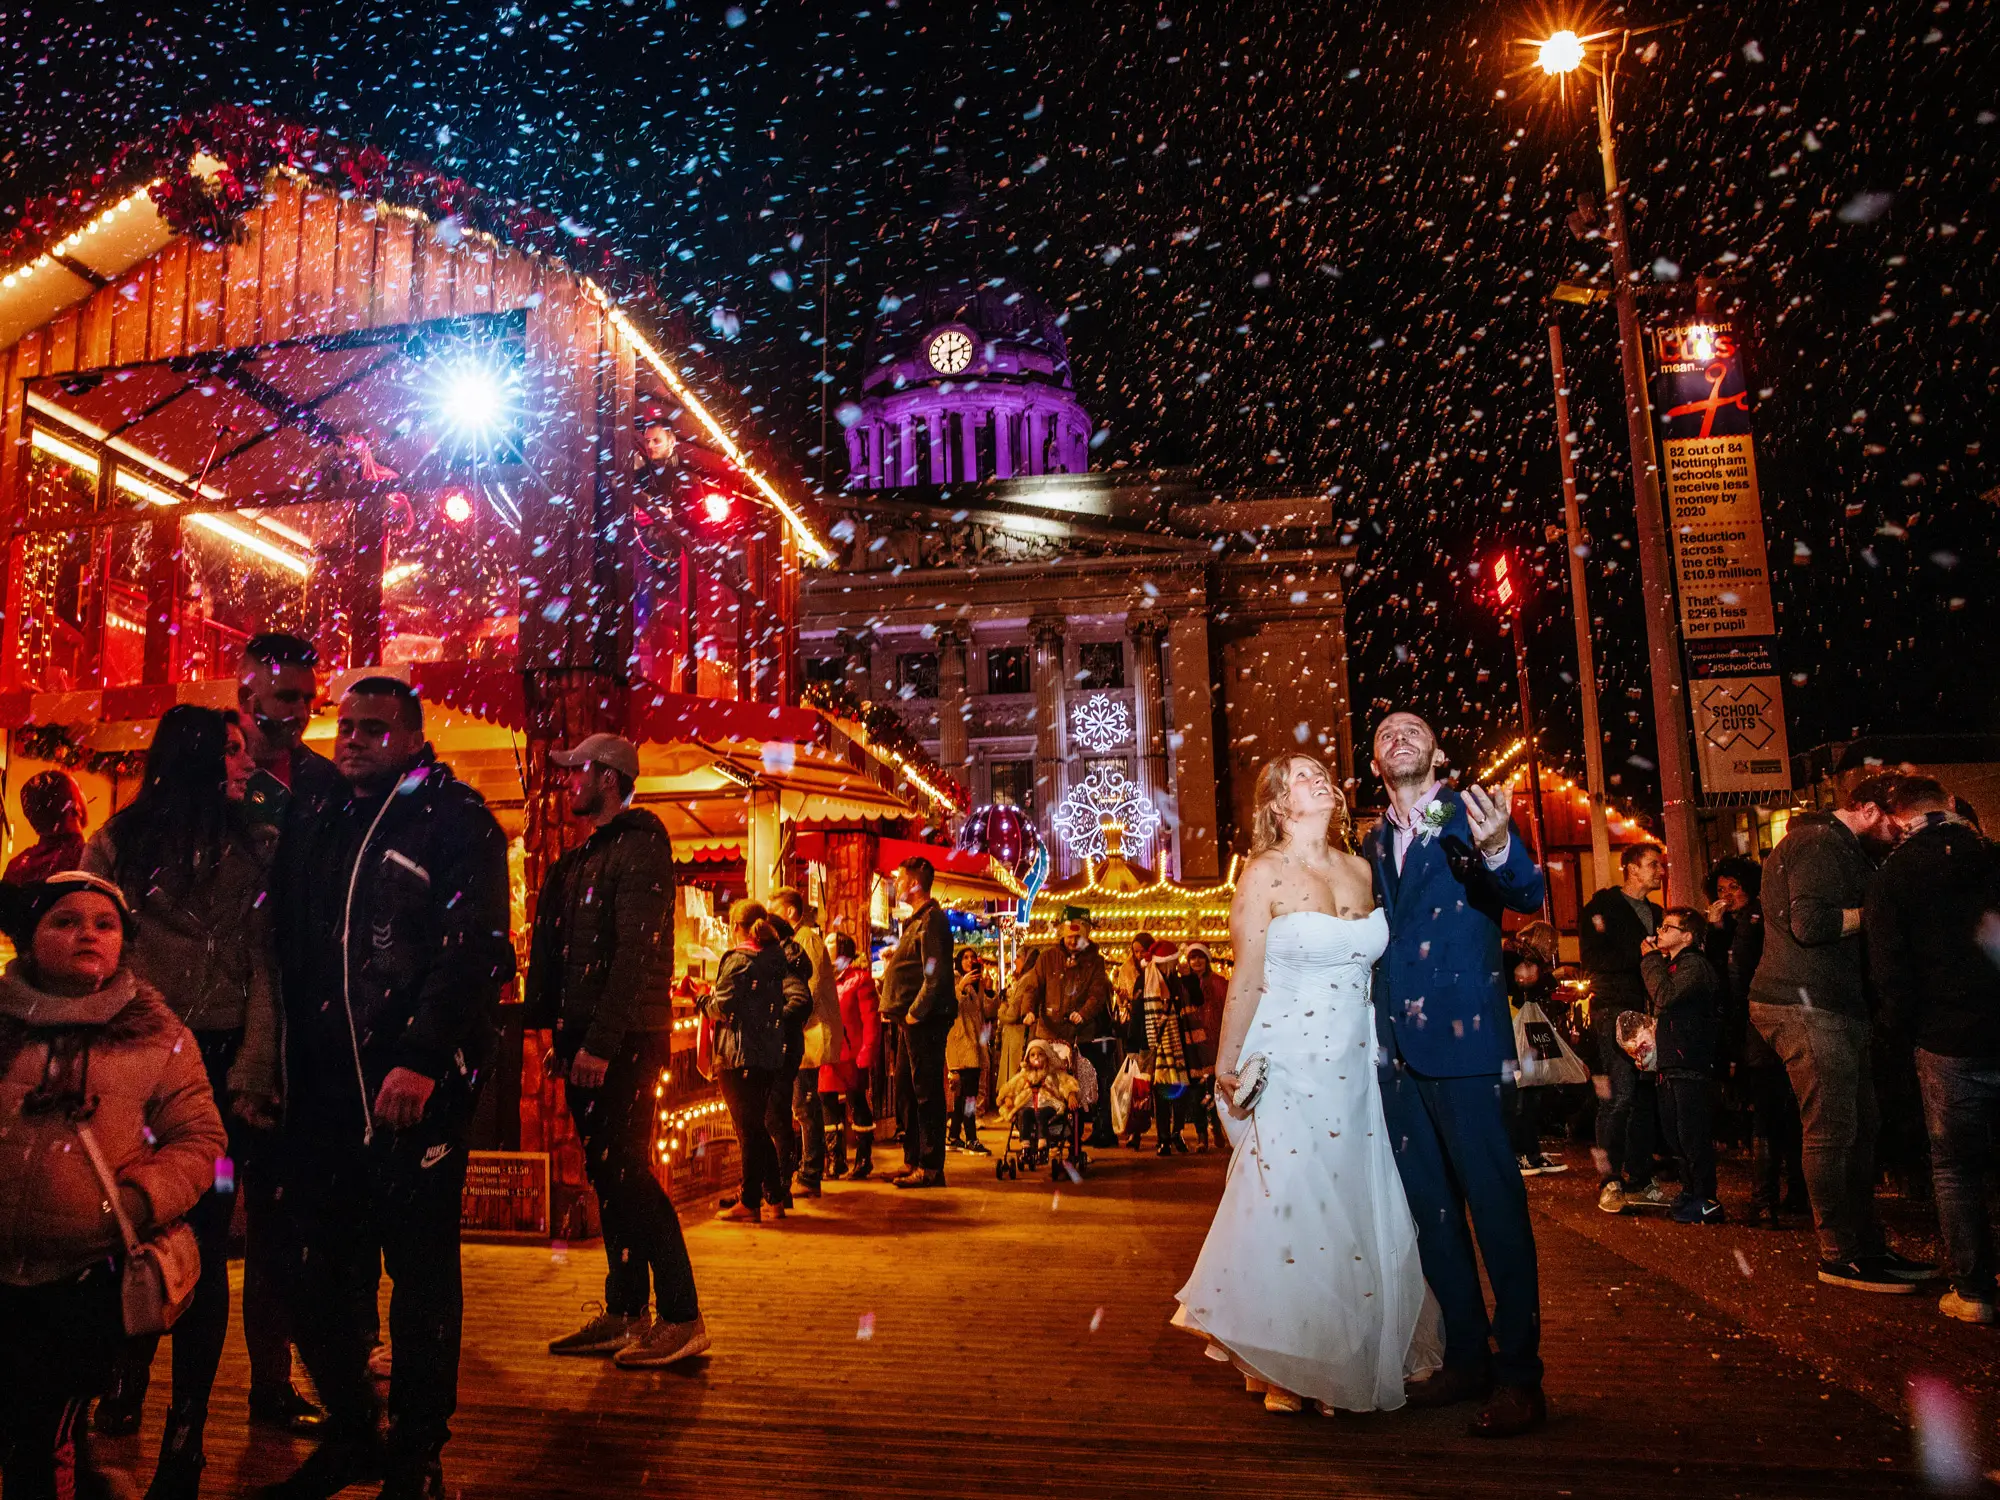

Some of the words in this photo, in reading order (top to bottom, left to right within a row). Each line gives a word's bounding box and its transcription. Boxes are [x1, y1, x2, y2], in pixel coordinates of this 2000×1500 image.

[1669, 447, 1685, 457] 82
[1687, 445, 1709, 456] out
[1711, 444, 1725, 455] of
[1728, 443, 1743, 453] 84
[1671, 456, 1747, 470] Nottingham
[1672, 468, 1723, 481] schools
[1725, 467, 1748, 477] will
[1673, 482, 1720, 493] receive
[1723, 480, 1750, 490] less
[1675, 494, 1719, 506] money
[1721, 493, 1737, 504] by
[1676, 506, 1706, 518] 2020
[1680, 531, 1746, 543] Reduction
[1681, 545, 1725, 556] across
[1682, 558, 1703, 568] the
[1706, 556, 1729, 568] city
[1683, 569, 1716, 581] £10.9
[1718, 567, 1762, 579] million
[1686, 595, 1725, 607] That's
[1687, 608, 1717, 619] £296
[1720, 607, 1748, 618] less
[1689, 622, 1711, 634] per
[1713, 619, 1745, 633] pupil
[1712, 704, 1763, 718] SCHOOL
[1722, 717, 1756, 730] CUTS
